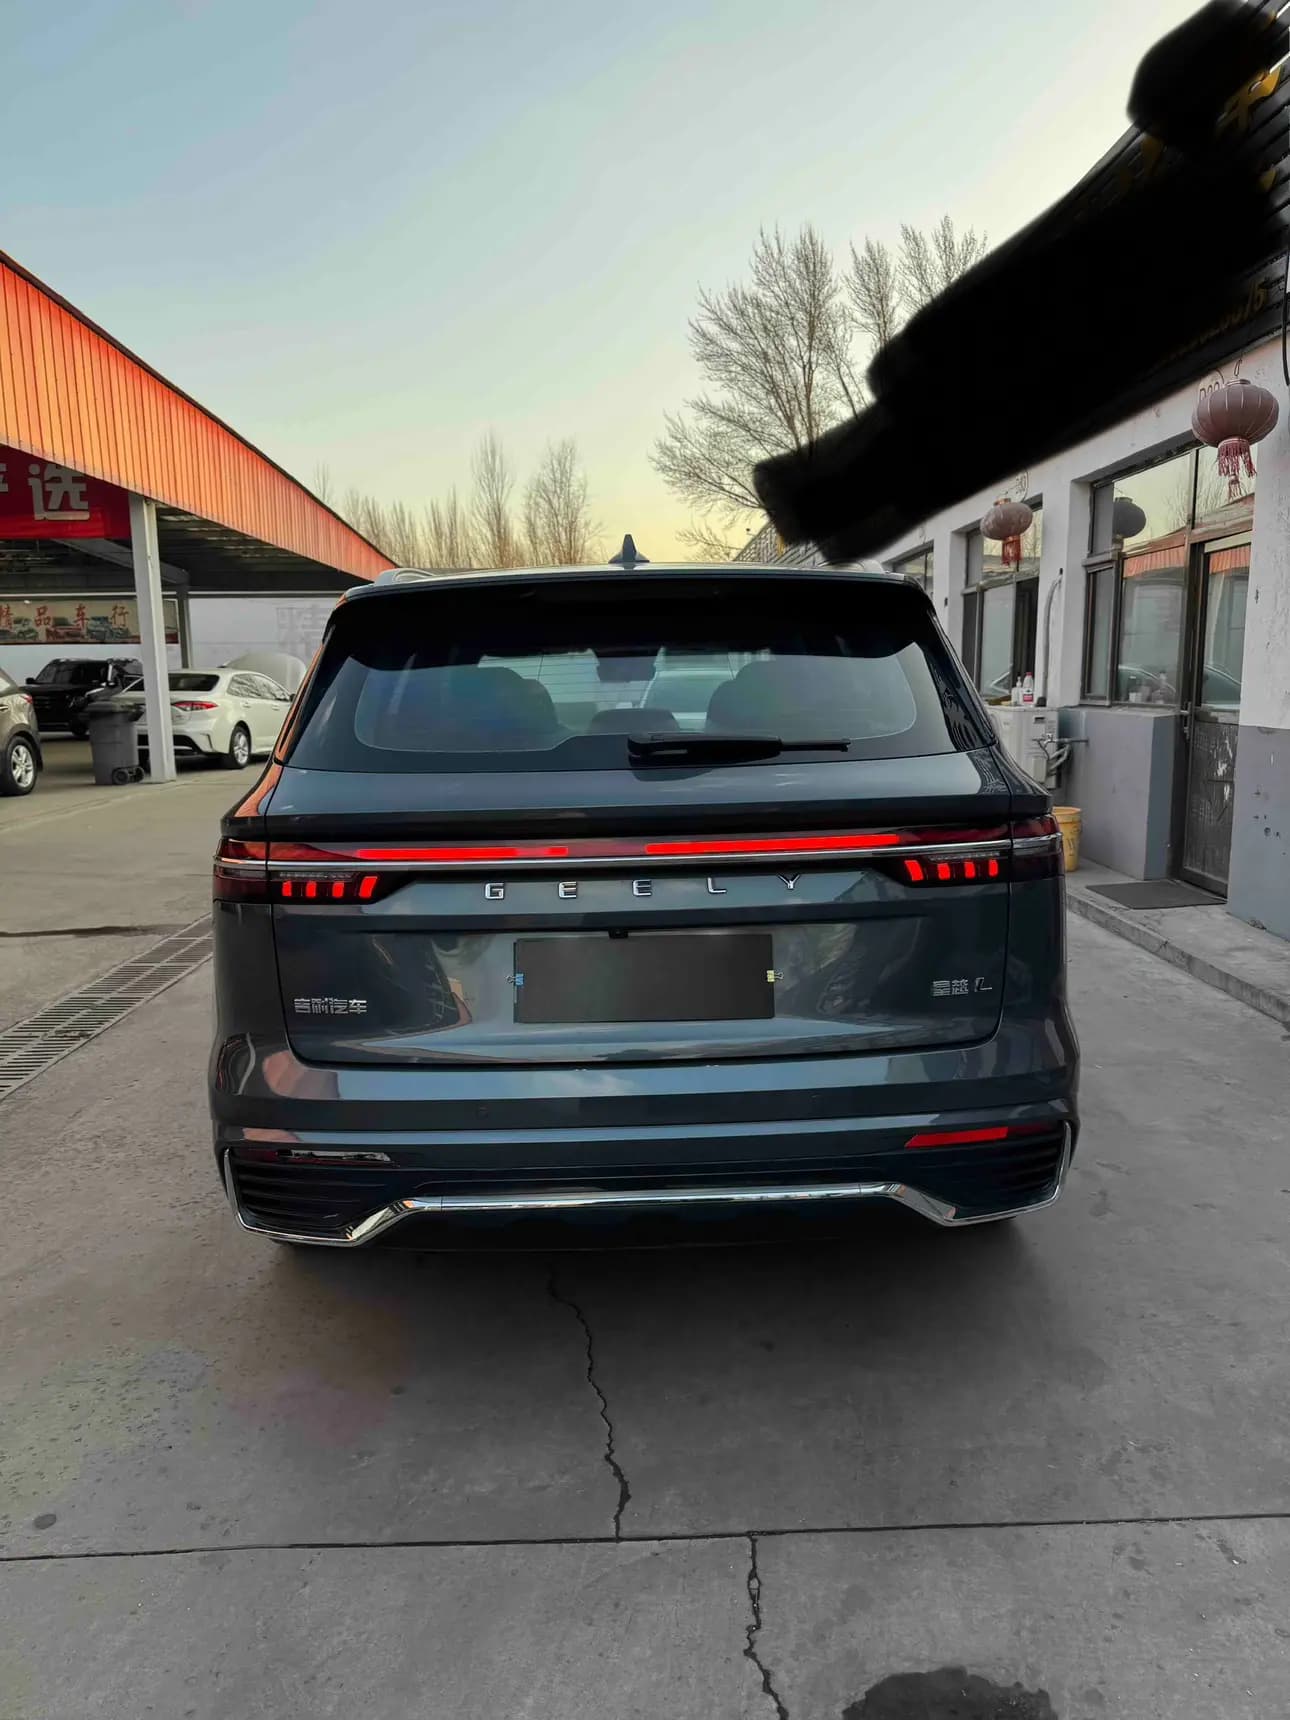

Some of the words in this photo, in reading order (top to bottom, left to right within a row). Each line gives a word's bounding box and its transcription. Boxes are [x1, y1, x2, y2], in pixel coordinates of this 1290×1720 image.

[0, 463, 90, 521] 选
[484, 872, 801, 900] GEELY
[932, 979, 969, 996] 星越
[974, 976, 993, 993] L
[293, 998, 368, 1014] 吉利汽车
